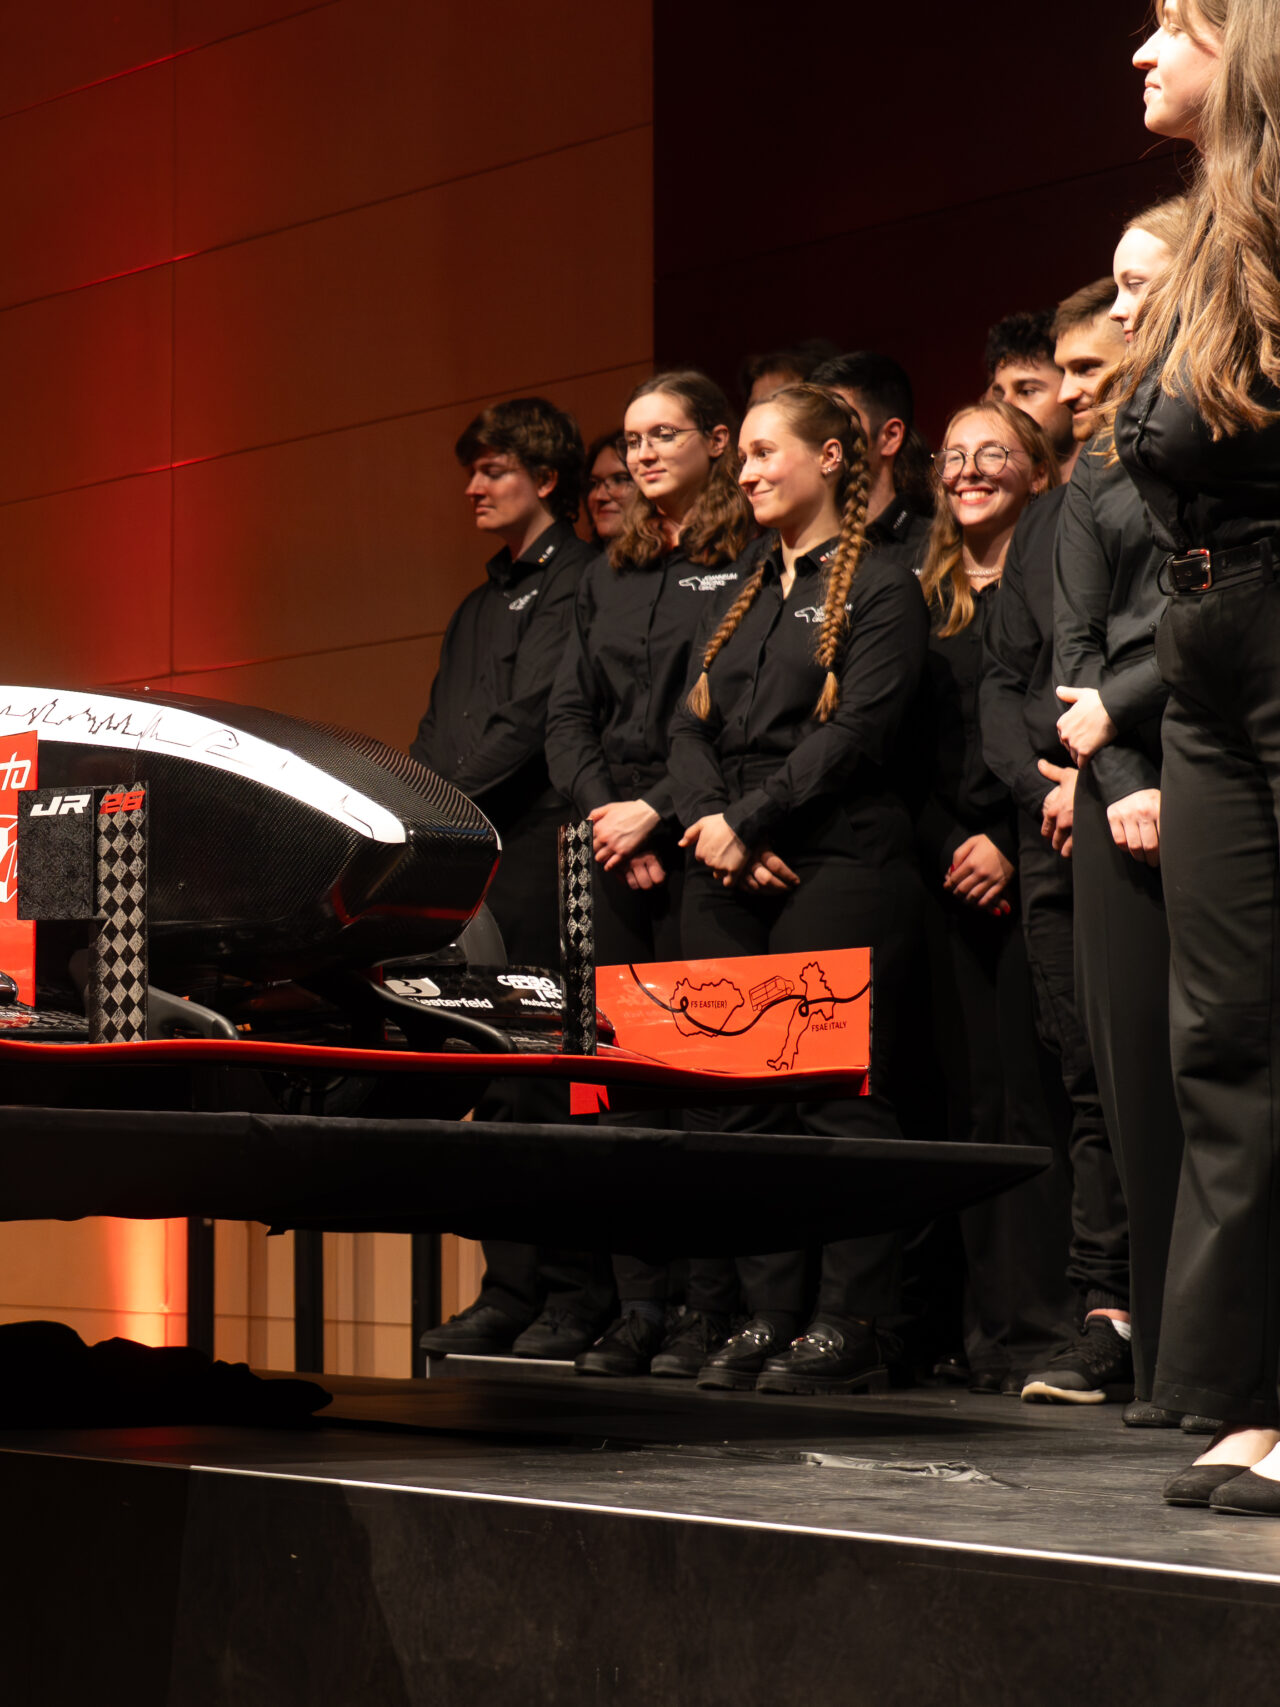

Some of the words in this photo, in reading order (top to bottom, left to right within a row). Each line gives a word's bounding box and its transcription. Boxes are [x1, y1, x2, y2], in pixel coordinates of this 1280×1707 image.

[29, 794, 91, 817] JR
[99, 790, 146, 815] 26
[699, 1000, 727, 1009] EAST(ER)
[811, 1022, 828, 1032] FSAE
[829, 1021, 847, 1031] ITALY
